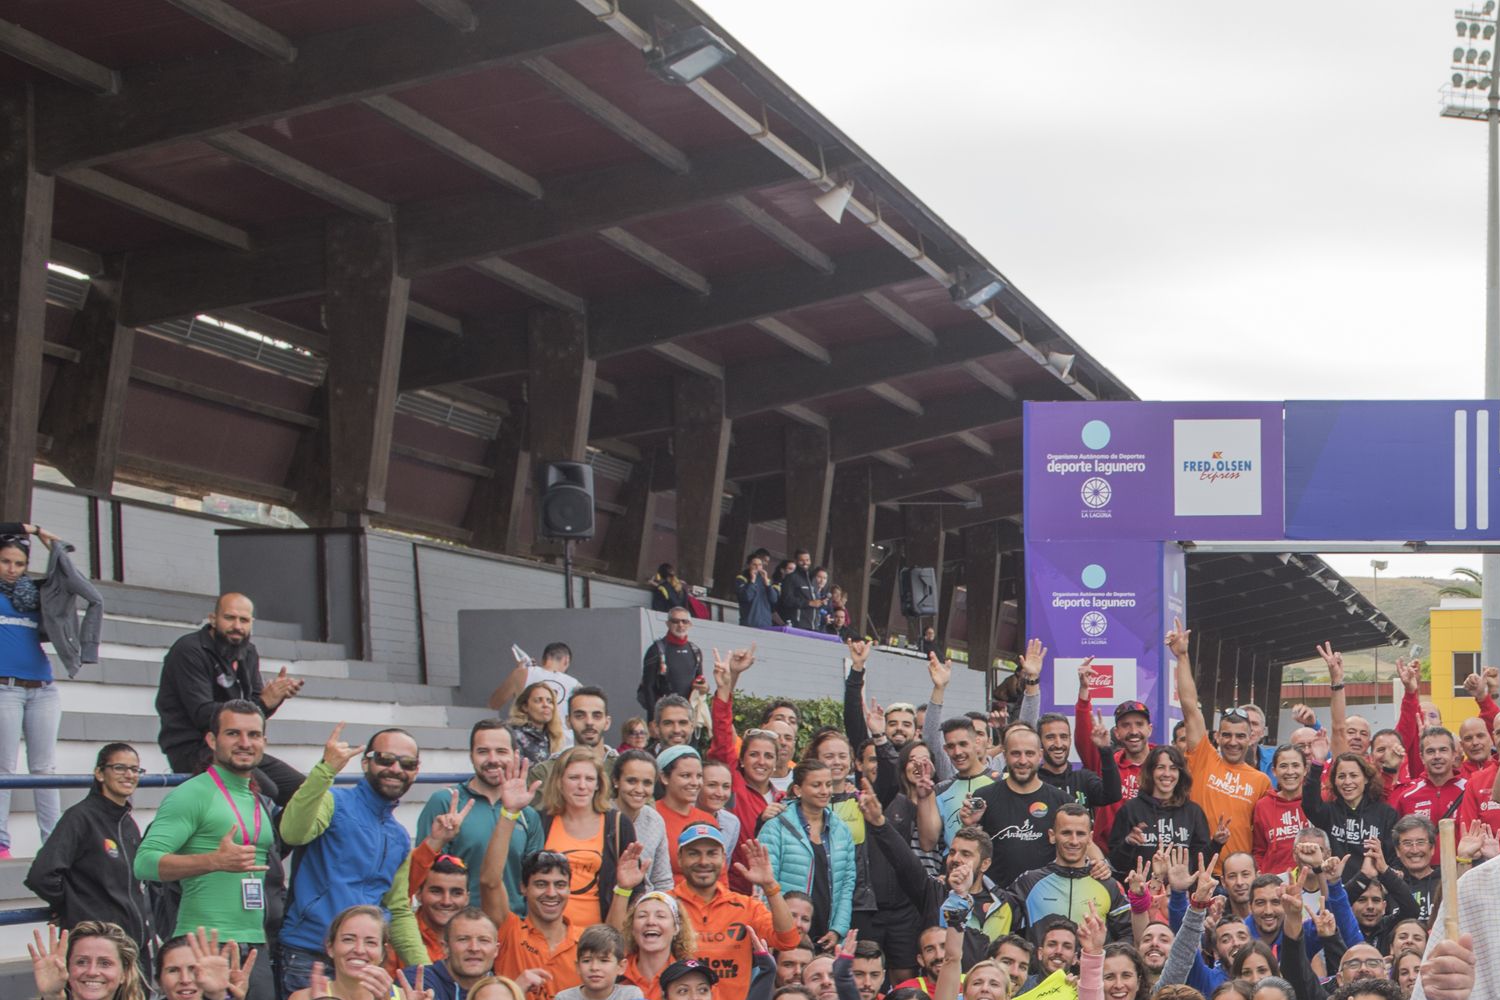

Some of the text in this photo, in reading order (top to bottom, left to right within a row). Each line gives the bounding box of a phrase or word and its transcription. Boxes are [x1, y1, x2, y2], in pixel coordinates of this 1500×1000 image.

[1047, 459, 1146, 475] deporte lagunero
[1199, 471, 1241, 483] Express
[1052, 597, 1136, 610] deporte lagunero
